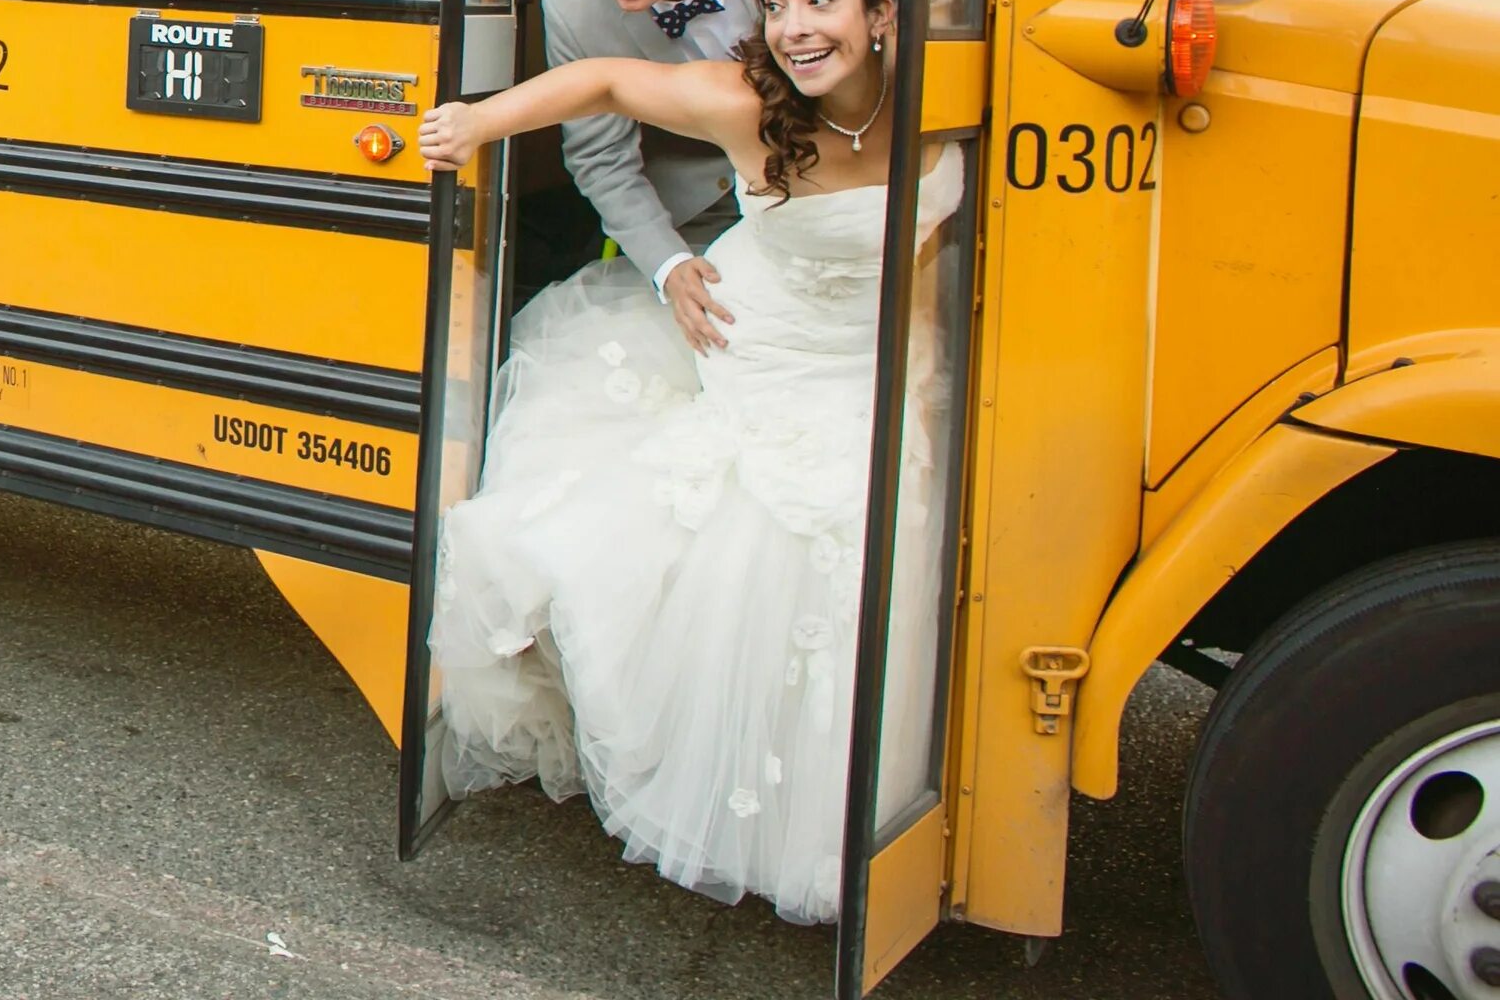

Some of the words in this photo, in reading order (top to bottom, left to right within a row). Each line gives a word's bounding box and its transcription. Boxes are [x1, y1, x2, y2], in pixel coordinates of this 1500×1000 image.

[151, 24, 234, 48] ROUTE
[301, 65, 418, 102] Thomas
[309, 96, 350, 108] BUILT
[356, 100, 406, 113] BUSES
[1006, 121, 1157, 193] 0302
[3, 365, 19, 387] NO.
[214, 414, 288, 454] USDOT
[297, 431, 391, 476] 354406
